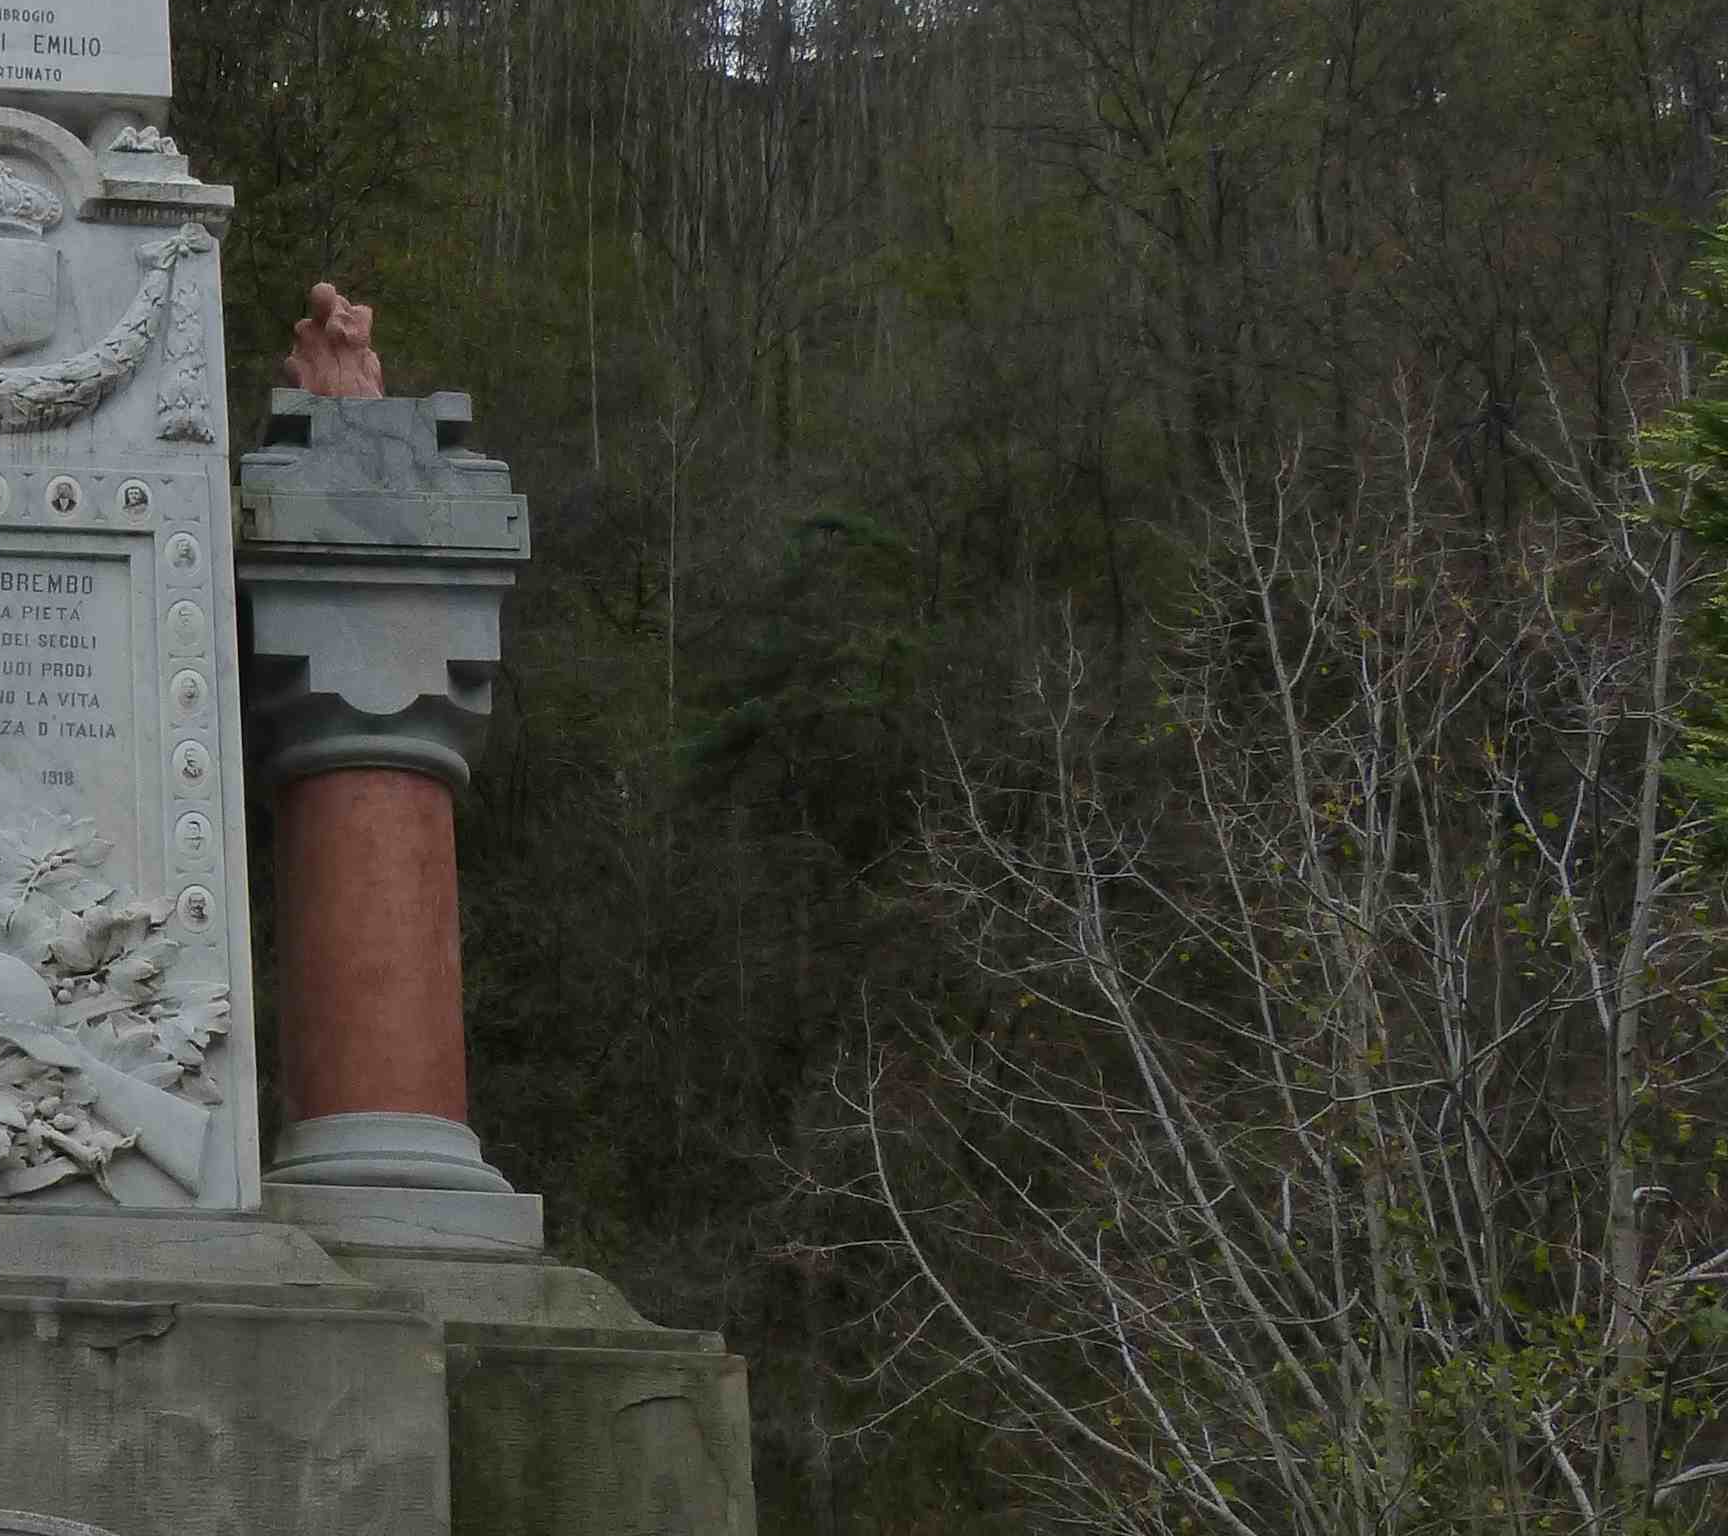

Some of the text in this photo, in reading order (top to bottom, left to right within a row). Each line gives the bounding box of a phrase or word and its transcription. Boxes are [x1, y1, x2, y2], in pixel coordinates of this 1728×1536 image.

[33, 34, 101, 57] EMILIO
[0, 572, 94, 594] BREMBO
[2, 632, 29, 648] DEI
[38, 634, 97, 649] SECOLI
[41, 663, 92, 678] PRODI
[26, 691, 49, 707] LA
[57, 692, 100, 708] VITA
